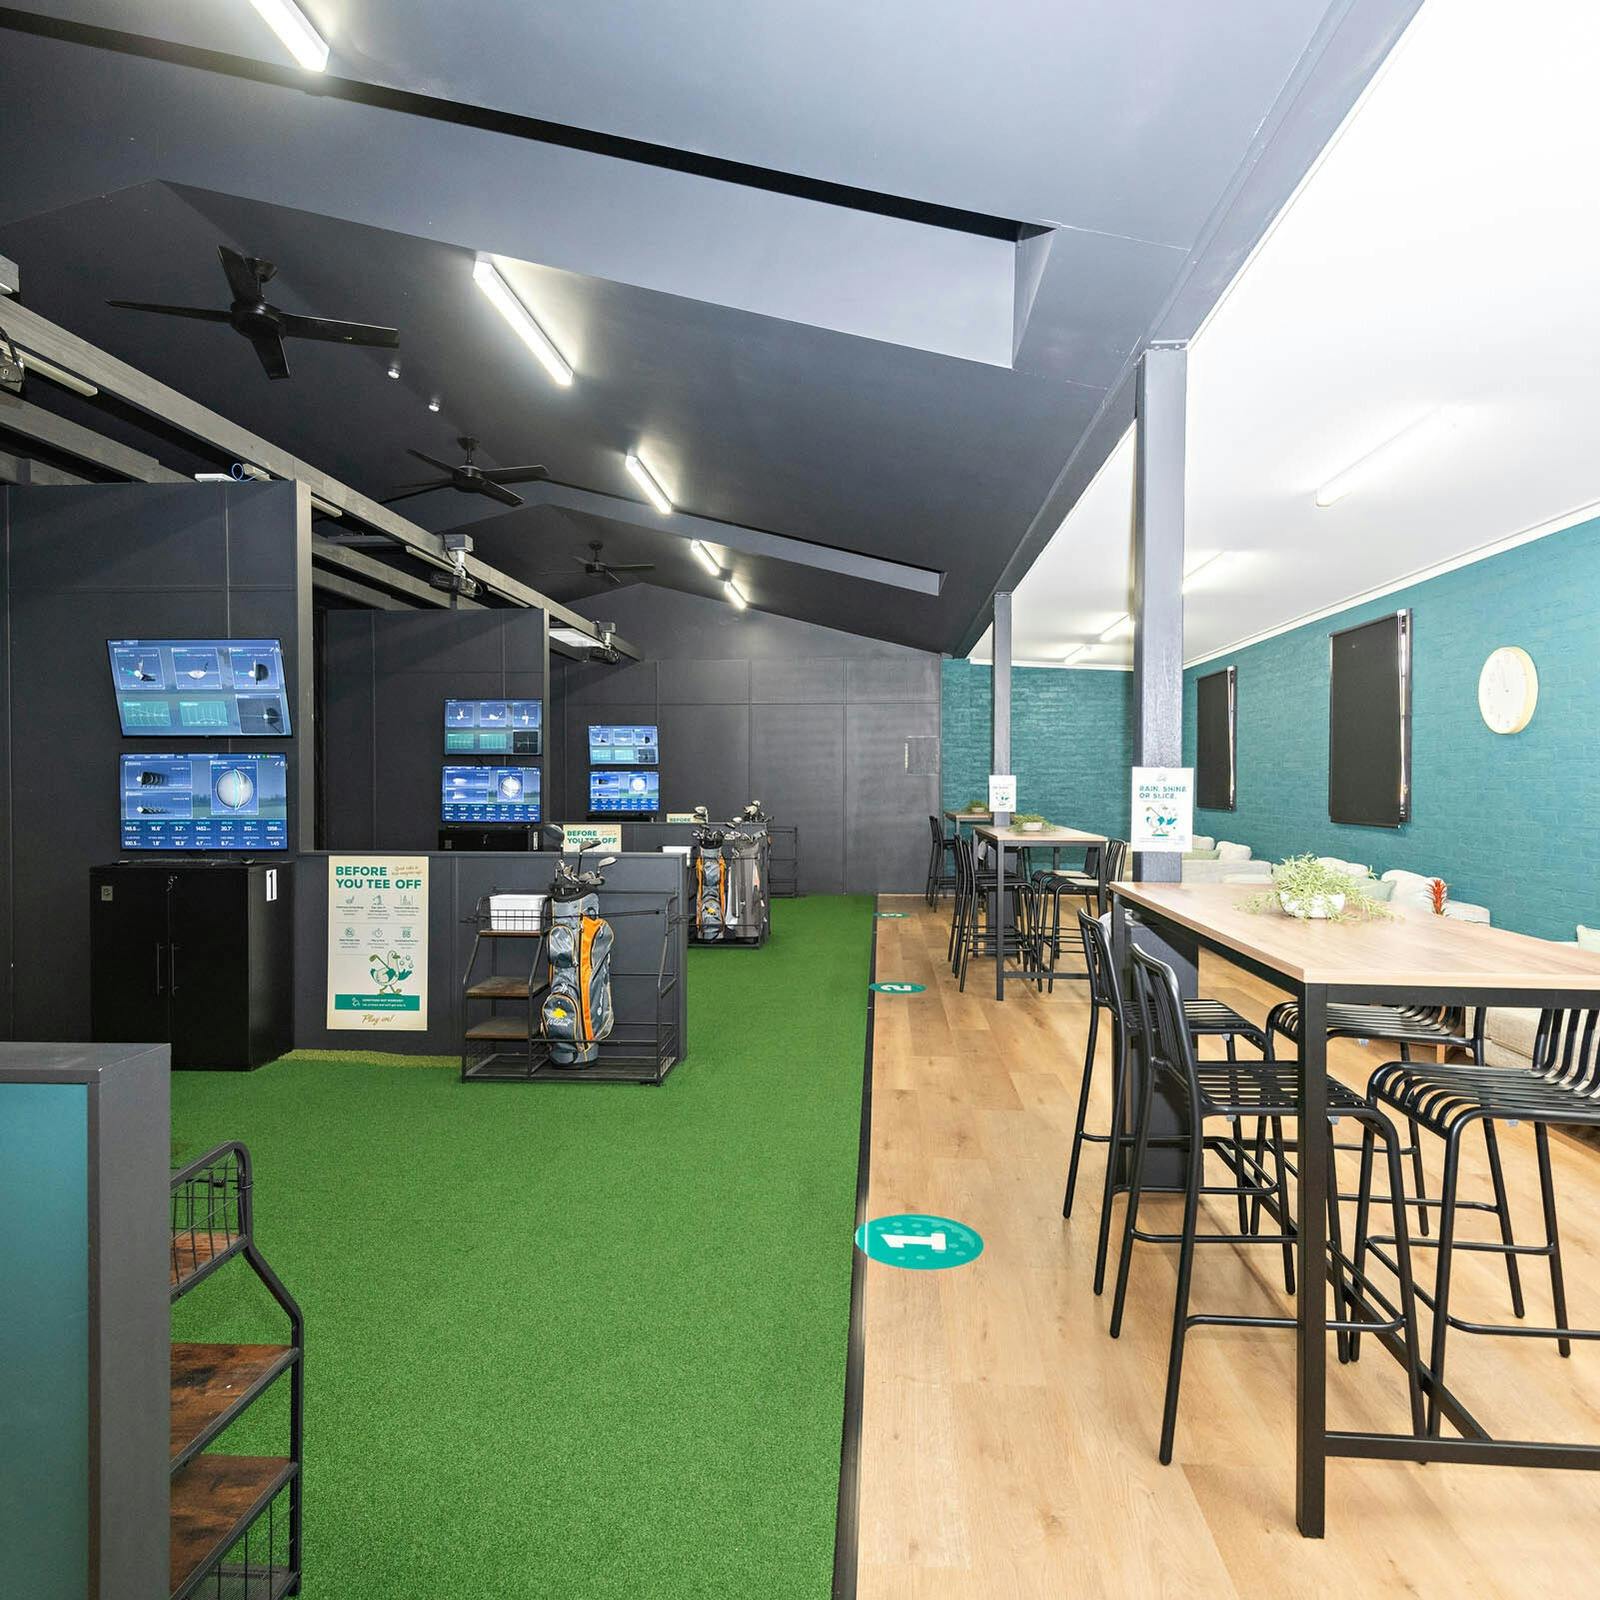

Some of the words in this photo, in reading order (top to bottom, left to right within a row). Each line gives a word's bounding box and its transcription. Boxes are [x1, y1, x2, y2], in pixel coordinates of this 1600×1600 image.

[336, 866, 387, 876] BEFORE
[336, 879, 363, 889] YOU
[367, 879, 390, 889] TEE
[395, 879, 421, 889] OFF
[880, 1232, 947, 1251] 1
